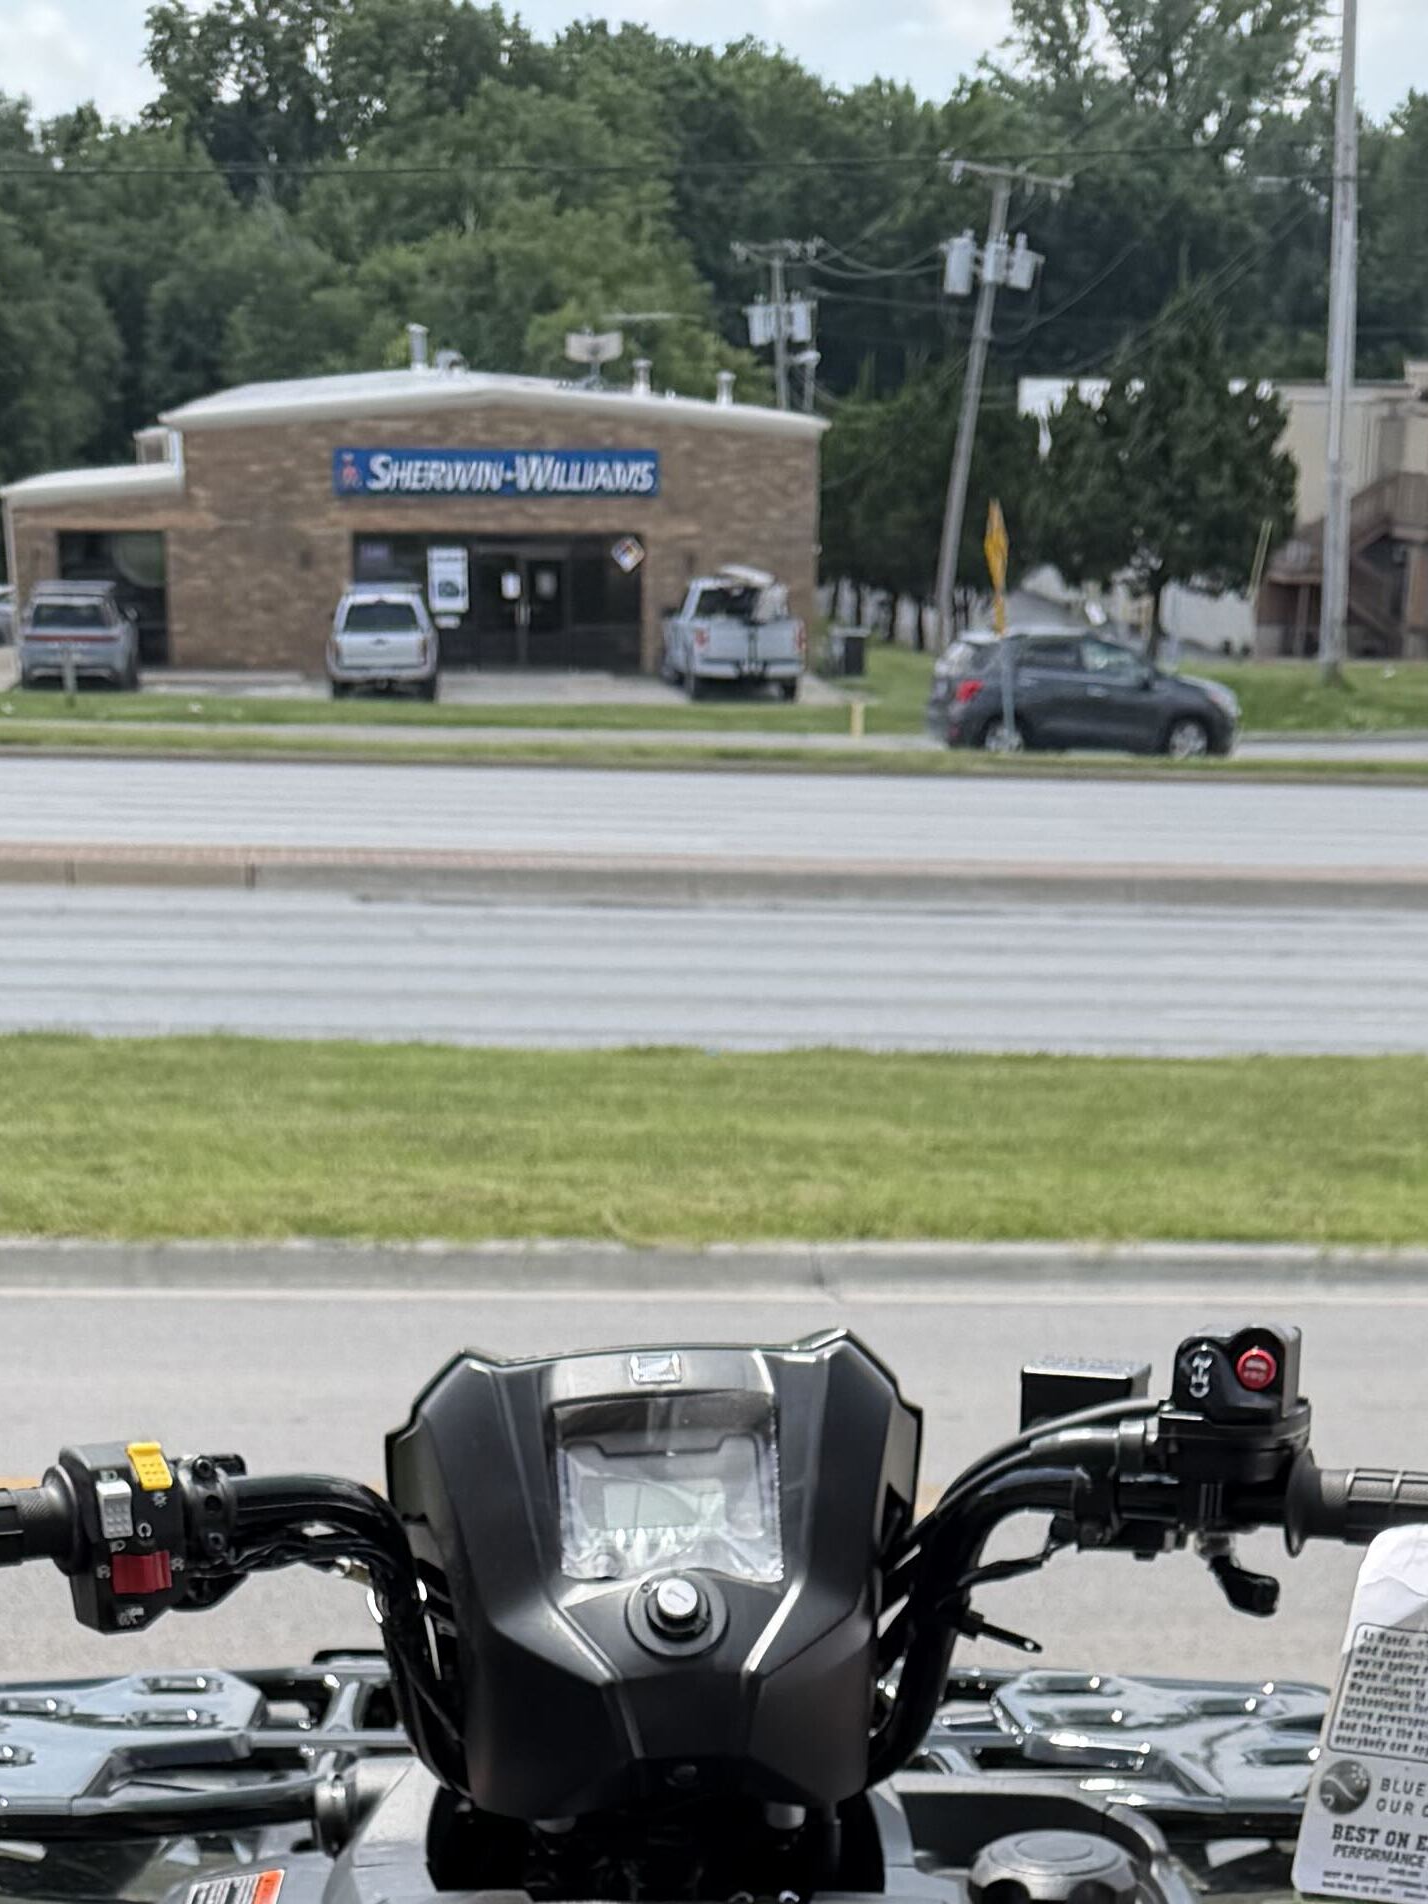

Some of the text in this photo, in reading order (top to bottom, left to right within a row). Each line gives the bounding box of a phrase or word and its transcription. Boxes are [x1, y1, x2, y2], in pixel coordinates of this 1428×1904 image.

[367, 454, 657, 492] SHERWIN-WILLIAMS
[1380, 1777, 1427, 1796] BLUE
[1375, 1798, 1414, 1817] OUR
[1331, 1823, 1379, 1845] BEST
[1385, 1830, 1410, 1848] ON
[1333, 1843, 1424, 1869] PERFORMANCE
